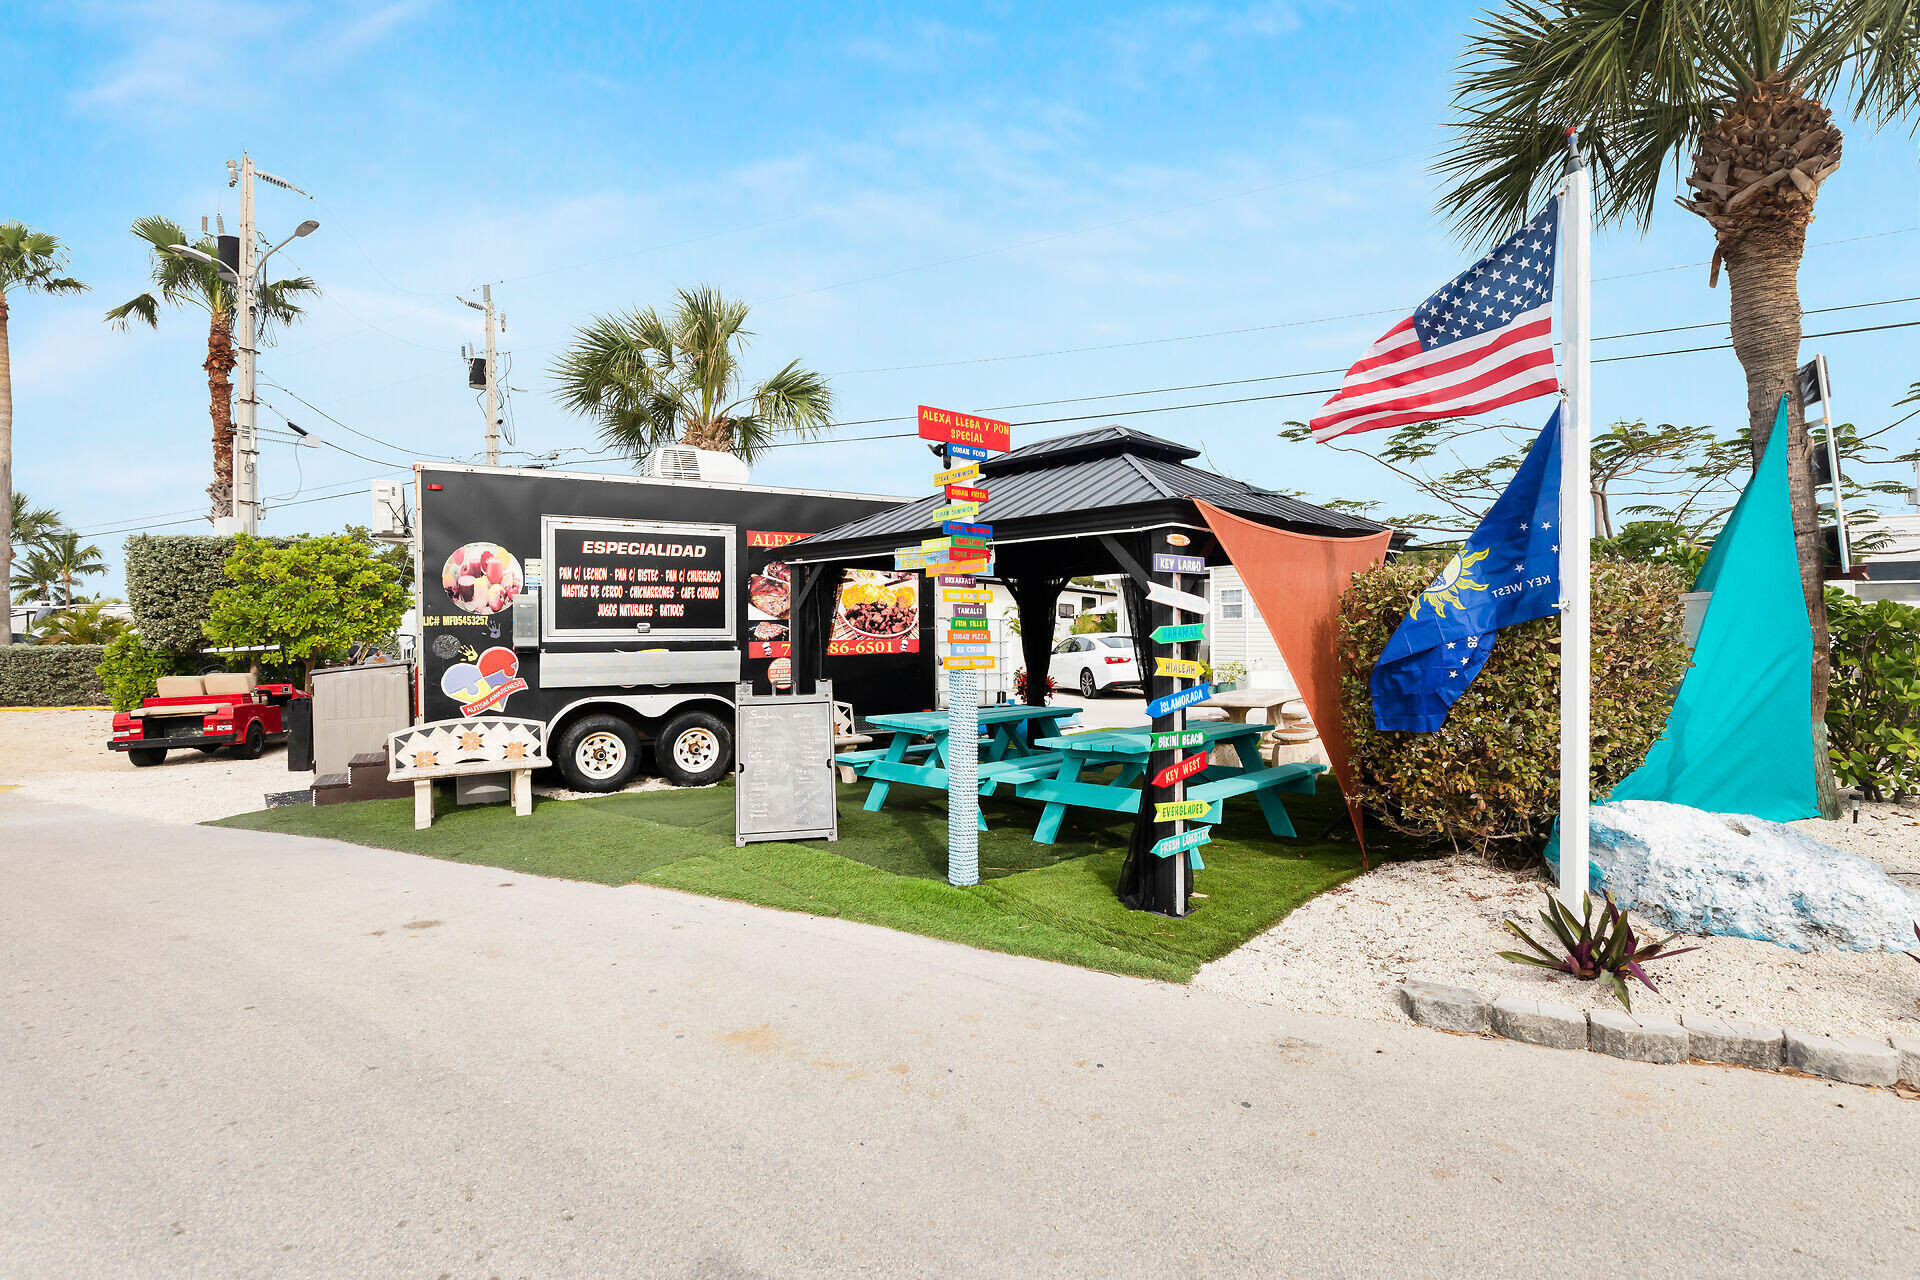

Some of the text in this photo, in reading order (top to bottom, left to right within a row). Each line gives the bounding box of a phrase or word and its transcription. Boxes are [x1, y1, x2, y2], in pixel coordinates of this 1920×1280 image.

[922, 410, 1009, 435] ALEXA LLEGA Y PON
[950, 428, 984, 443] SPECIAL
[952, 446, 986, 458] CUBAN FOOD
[952, 469, 974, 479] SANDWICH
[951, 488, 987, 499] CUBAN FRITA
[951, 506, 974, 515] SANDWICH
[581, 540, 707, 558] ESPECIALIDAD
[1160, 557, 1201, 572] KEY LARGO
[559, 566, 572, 580] PAN
[573, 565, 581, 582] C/
[583, 566, 608, 581] LECHON
[614, 567, 627, 581] PAN
[628, 566, 636, 583] C/
[637, 568, 659, 582] BISTEC
[665, 569, 678, 582] PAN
[678, 568, 686, 584] C/
[687, 569, 722, 583] CHURRASCO
[944, 576, 975, 585] BREAKFAST
[590, 584, 600, 599] DE
[601, 584, 624, 599] CERDO
[629, 585, 675, 599] CHICHARRONES
[680, 586, 696, 599] CAFE
[696, 586, 720, 600] CUBANO
[597, 603, 618, 617] JUGOS
[619, 603, 654, 617] NATURALES
[659, 603, 685, 617] BATIDOS
[957, 607, 983, 615] TAMALES
[442, 615, 489, 626] MFD5453257
[955, 620, 987, 628] FISH FILLET
[1162, 626, 1199, 640] BAHAMAS
[828, 641, 894, 654] 86-6501
[1165, 662, 1196, 675] HIALEAH
[466, 680, 523, 713] AUTISM AWARENESS
[1160, 689, 1204, 713] ISLAMORADA
[1158, 732, 1204, 748] BIKINI BEACH
[1165, 757, 1201, 783] KEY WEST
[1162, 803, 1204, 818] EVERGLADES
[1160, 827, 1209, 855] FRESH LOBSTER
